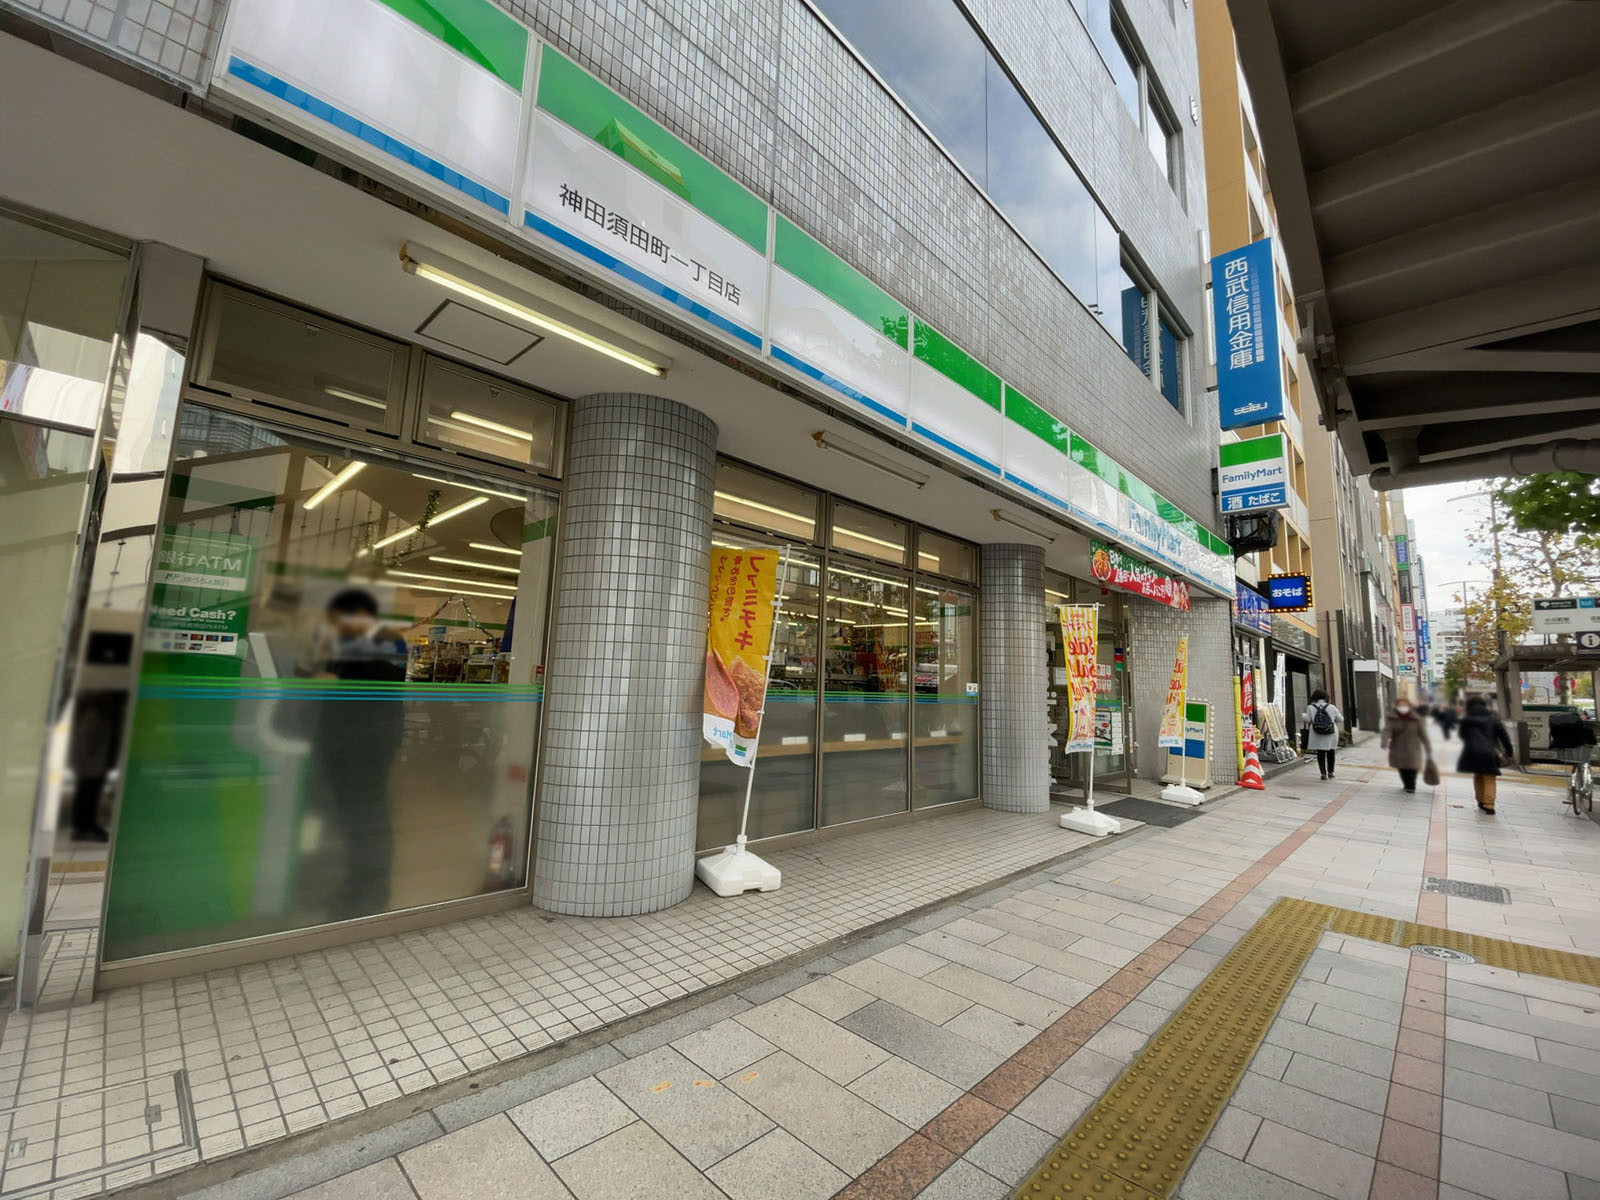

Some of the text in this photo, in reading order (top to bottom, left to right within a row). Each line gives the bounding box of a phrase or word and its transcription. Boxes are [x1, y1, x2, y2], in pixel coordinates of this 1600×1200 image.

[558, 183, 741, 307] 神田須田町一丁目店
[1225, 256, 1254, 371] 西武信用金庫
[1222, 466, 1283, 484] FamilyMart
[1228, 492, 1281, 510] 酒 たばこ
[1272, 587, 1303, 598] おそば
[189, 608, 237, 621] Cash?
